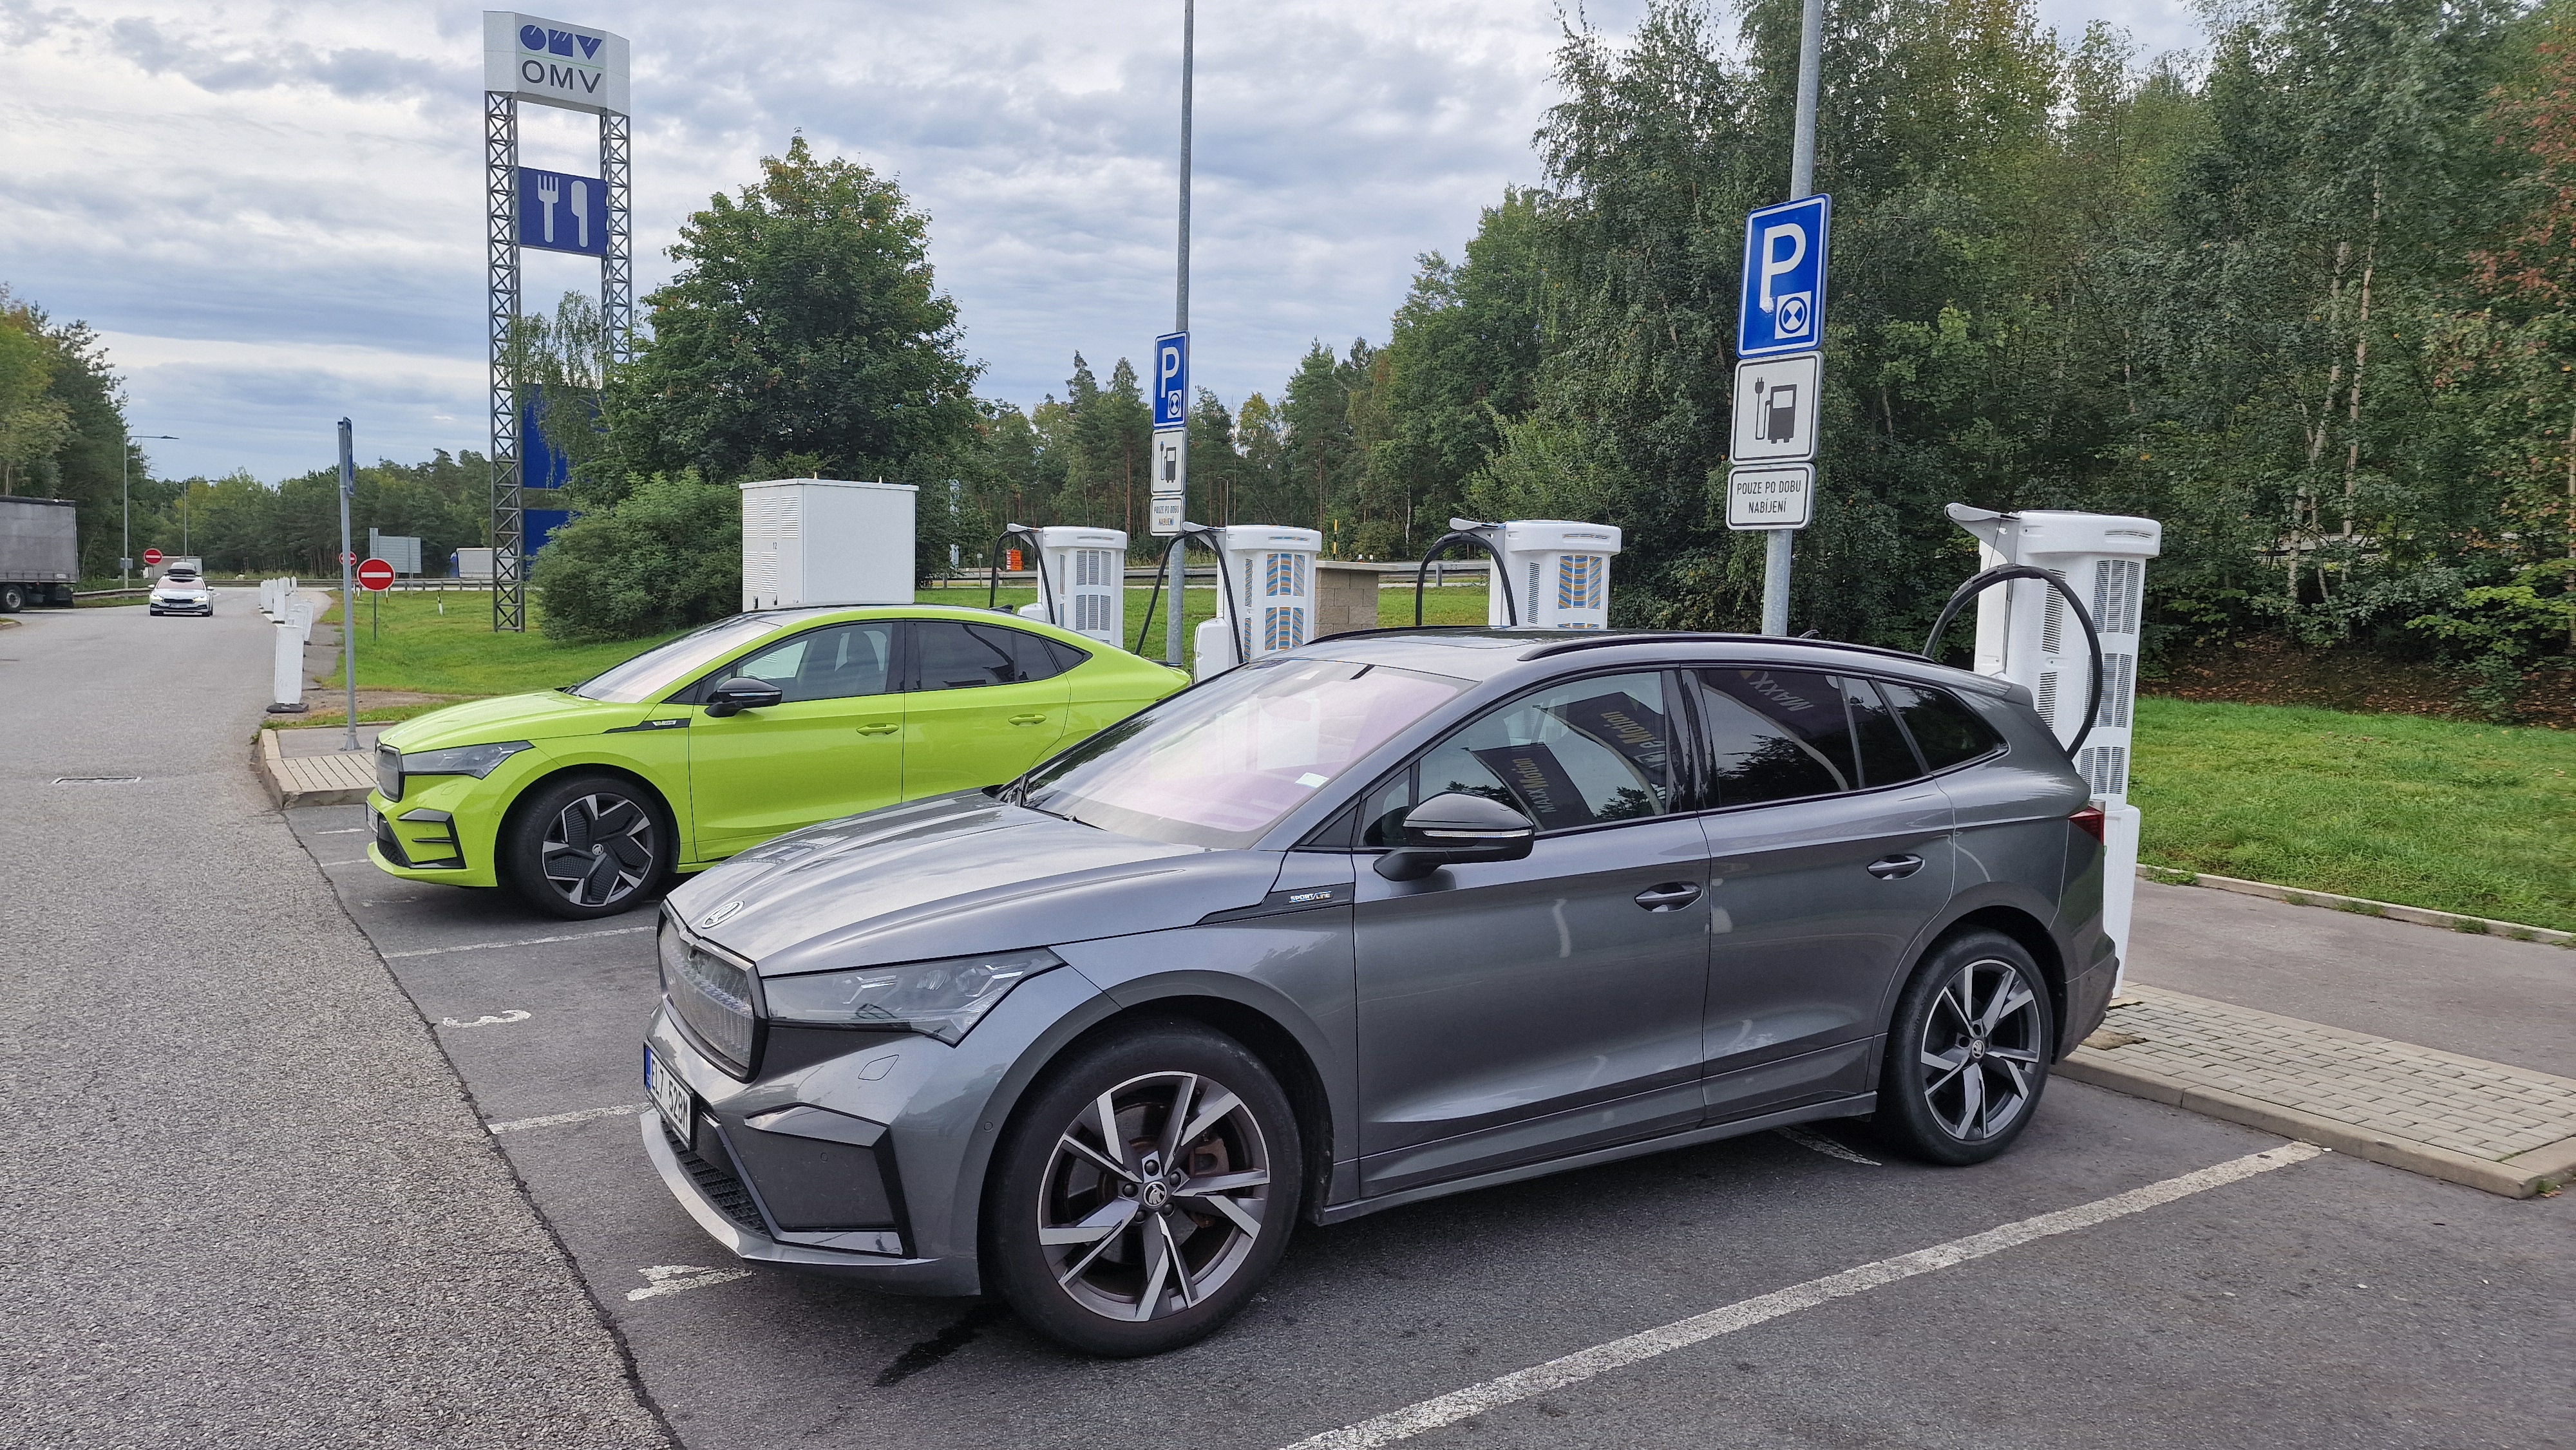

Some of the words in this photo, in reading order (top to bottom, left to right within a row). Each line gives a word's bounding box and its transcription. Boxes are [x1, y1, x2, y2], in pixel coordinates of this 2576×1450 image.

[522, 60, 601, 93] OMV
[1759, 223, 1806, 312] P
[1160, 346, 1180, 399] P
[1737, 482, 1763, 494] POUZE
[1765, 481, 1776, 493] PO
[1779, 480, 1801, 493] DOBU
[1748, 498, 1787, 514] NABÍJENÍ
[651, 1057, 664, 1099] EL7
[668, 1078, 688, 1132] 52BM
